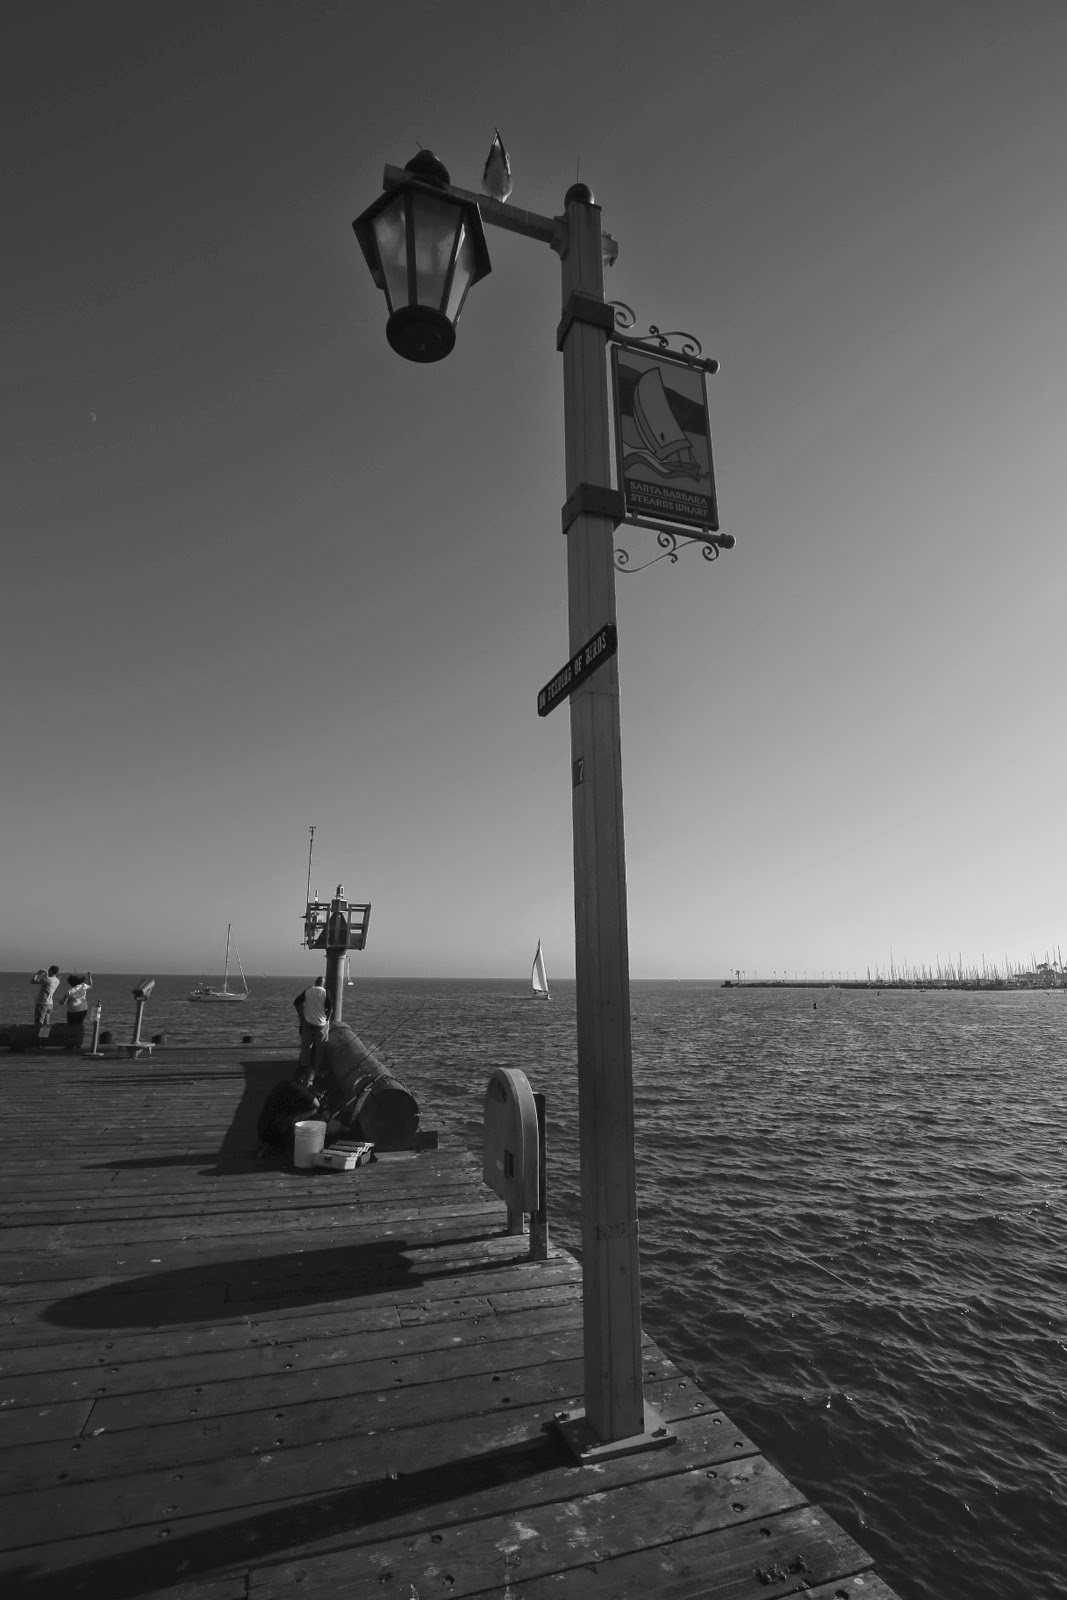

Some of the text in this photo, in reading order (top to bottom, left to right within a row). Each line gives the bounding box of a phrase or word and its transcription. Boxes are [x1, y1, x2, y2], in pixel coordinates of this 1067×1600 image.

[630, 481, 708, 506] SANTA BARBARA
[630, 493, 709, 517] STEARNS WHARF
[547, 666, 572, 701] FEEDING
[574, 655, 583, 675] OF
[585, 631, 607, 665] BIRDS
